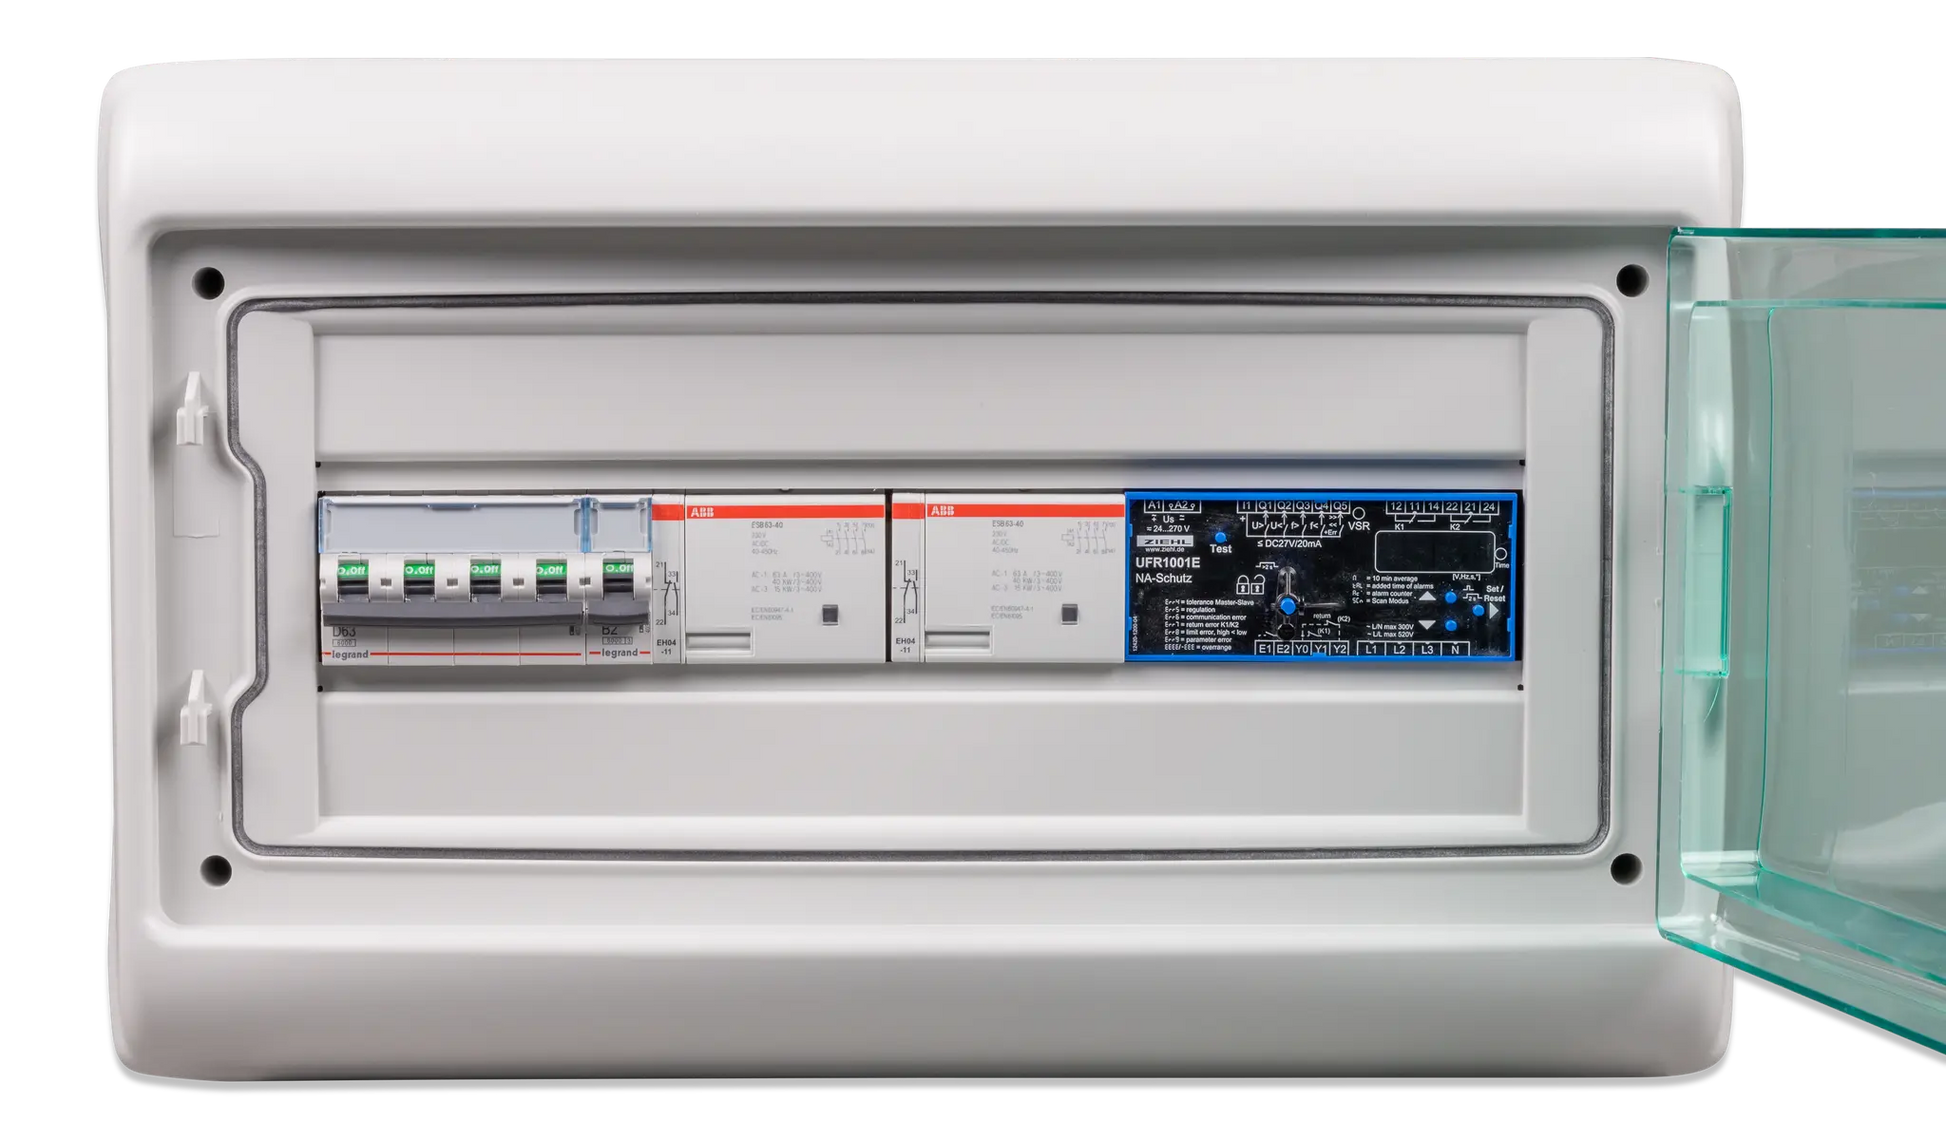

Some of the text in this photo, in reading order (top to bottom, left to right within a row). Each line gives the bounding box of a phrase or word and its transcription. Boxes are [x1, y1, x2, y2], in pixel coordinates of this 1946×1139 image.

[1148, 501, 1161, 509] A1
[1174, 501, 1188, 509] A2
[1258, 500, 1272, 510] Q1
[1277, 500, 1291, 510] Q2
[1296, 500, 1310, 510] Q3
[1314, 500, 1329, 510] Q4
[1333, 500, 1347, 510] Q5
[1391, 502, 1403, 511] 12
[1409, 502, 1420, 511] 11
[1428, 502, 1440, 511] 14
[1446, 502, 1459, 511] 22
[1464, 502, 1476, 511] 21
[1483, 502, 1496, 511] 24
[690, 507, 714, 517] ABB
[931, 506, 954, 516] ABB
[1162, 515, 1175, 524] Us
[1348, 521, 1370, 531] VSR
[1265, 539, 1322, 548] DC27V/20mA
[1209, 544, 1232, 553] Test
[1135, 557, 1201, 568] UFR1001E
[1135, 573, 1193, 583] NA-Schutz
[1486, 585, 1500, 593] Set
[1215, 598, 1255, 606] Master-Slave
[1483, 594, 1506, 602] Reset
[1186, 606, 1216, 614] regulation
[1216, 629, 1230, 637] high
[656, 639, 677, 647] EH04
[895, 637, 916, 645] EH04
[1259, 644, 1271, 653] E1
[1276, 644, 1290, 653] E2
[1295, 644, 1309, 653] Y0
[1314, 644, 1327, 653] Y1
[1333, 644, 1346, 653] Y2
[1366, 645, 1377, 654] L1
[1394, 645, 1406, 654] L2
[1421, 645, 1434, 654] L3
[1452, 645, 1460, 654] N
[332, 650, 369, 661] legrand
[602, 648, 638, 659] legrand
